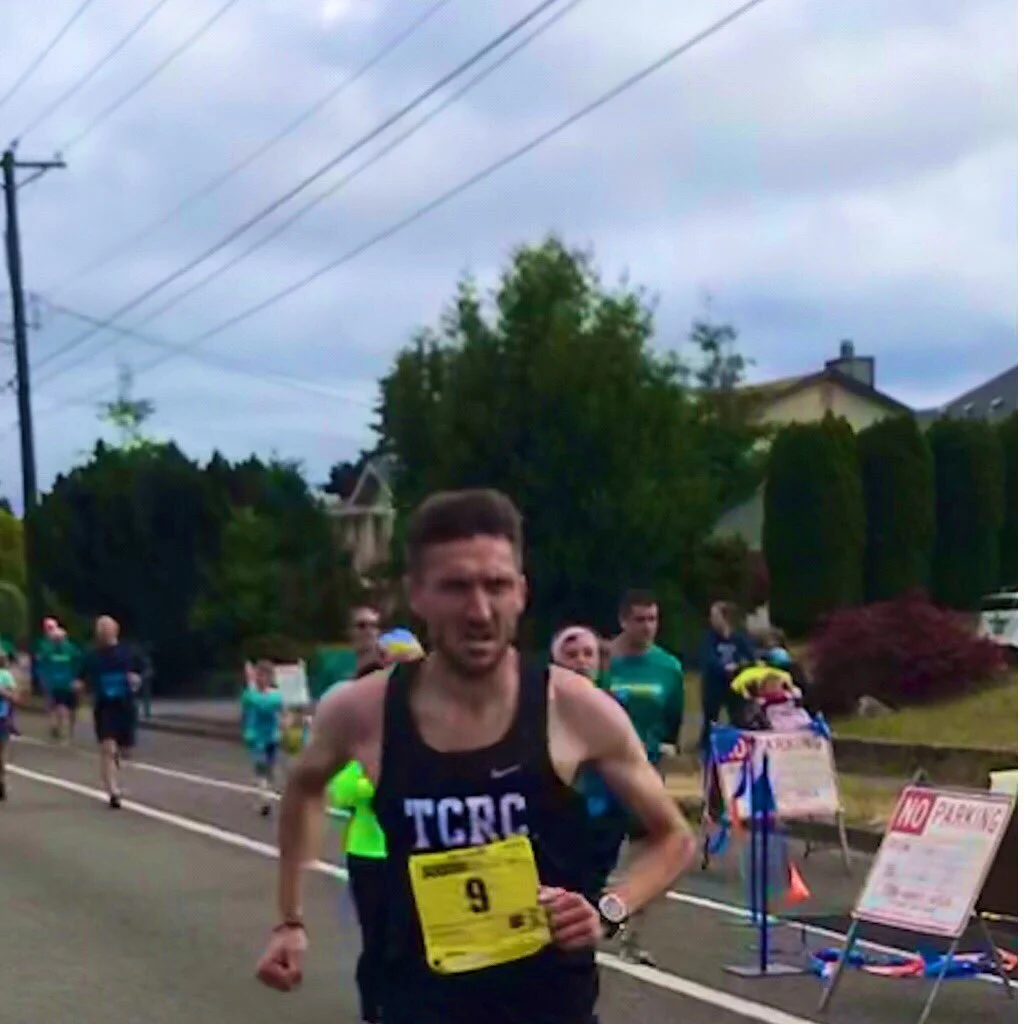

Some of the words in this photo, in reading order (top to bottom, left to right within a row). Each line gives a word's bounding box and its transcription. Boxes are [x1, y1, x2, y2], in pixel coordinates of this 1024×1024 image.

[404, 793, 529, 849] TCRC
[899, 797, 932, 829] NO
[932, 800, 1003, 835] PARKING
[465, 877, 490, 913] 9
